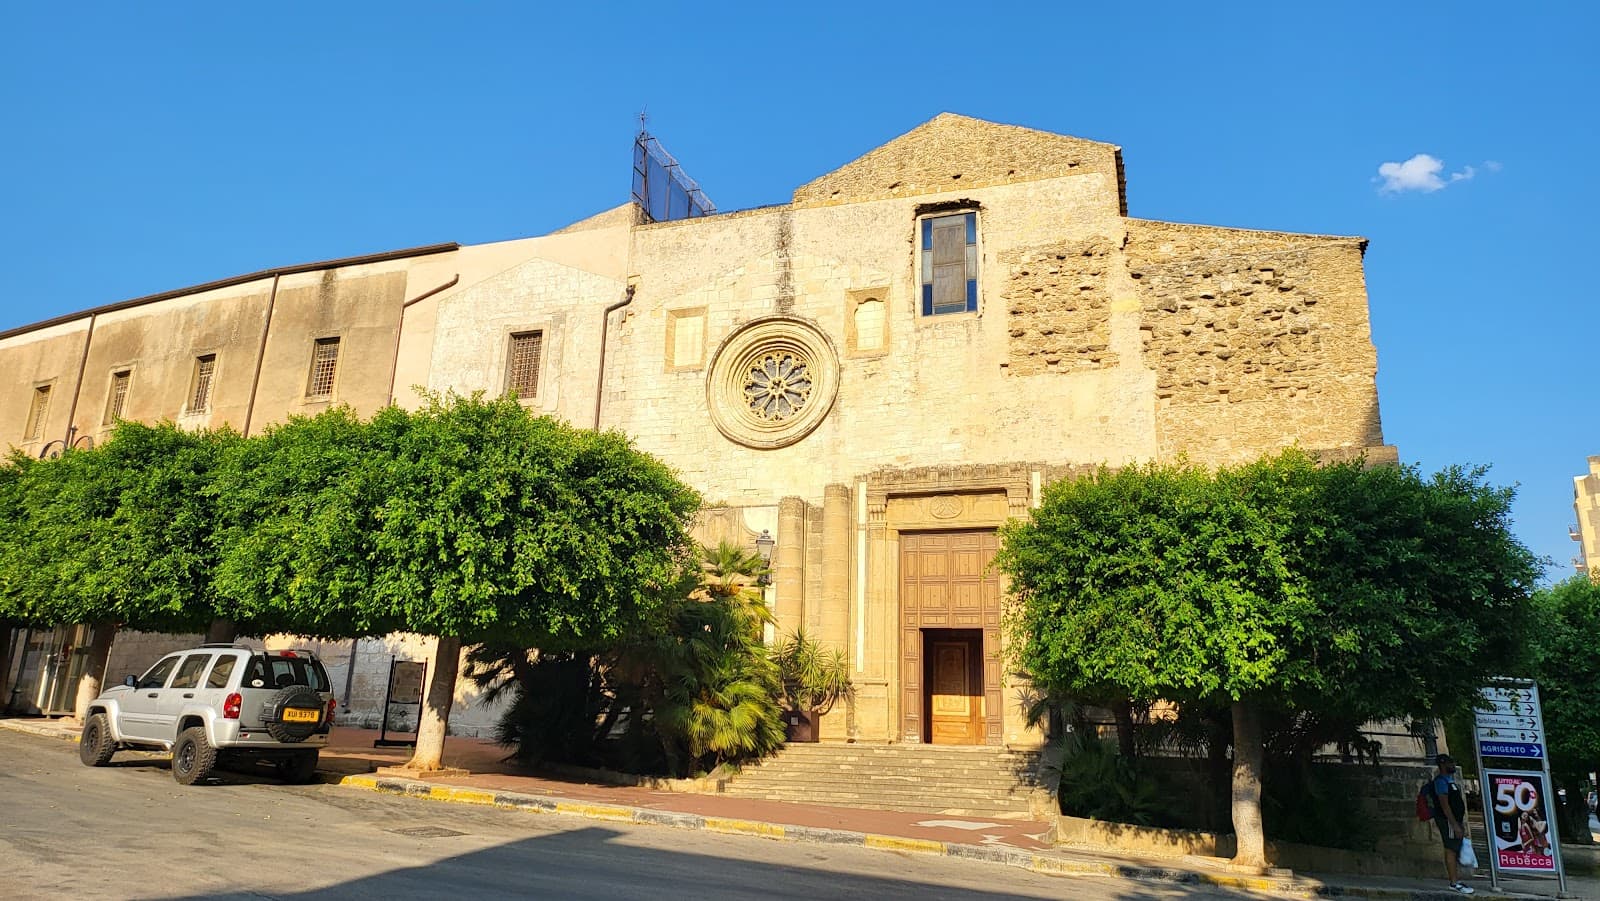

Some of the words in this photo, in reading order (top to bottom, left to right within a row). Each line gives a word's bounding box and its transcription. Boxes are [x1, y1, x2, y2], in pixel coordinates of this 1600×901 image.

[1477, 716, 1510, 725] biblioteca
[1482, 745, 1526, 754] AGRIGENTO
[1500, 854, 1552, 866] Rebecca
